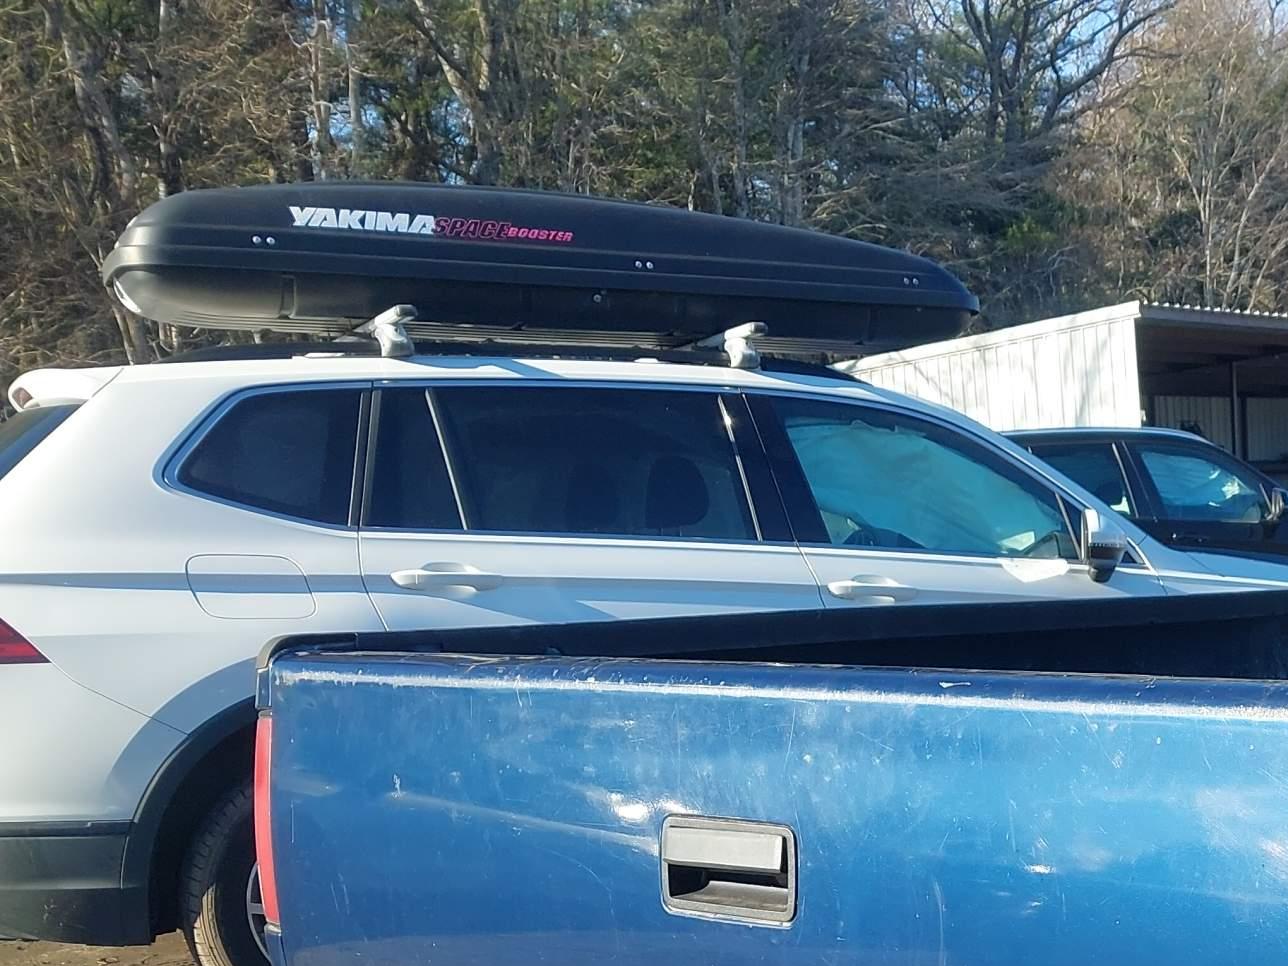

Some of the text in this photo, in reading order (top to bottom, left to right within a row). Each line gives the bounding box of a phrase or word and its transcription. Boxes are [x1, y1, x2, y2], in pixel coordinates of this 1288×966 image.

[288, 205, 574, 243] YAKIMA SPACE BOOSTER
